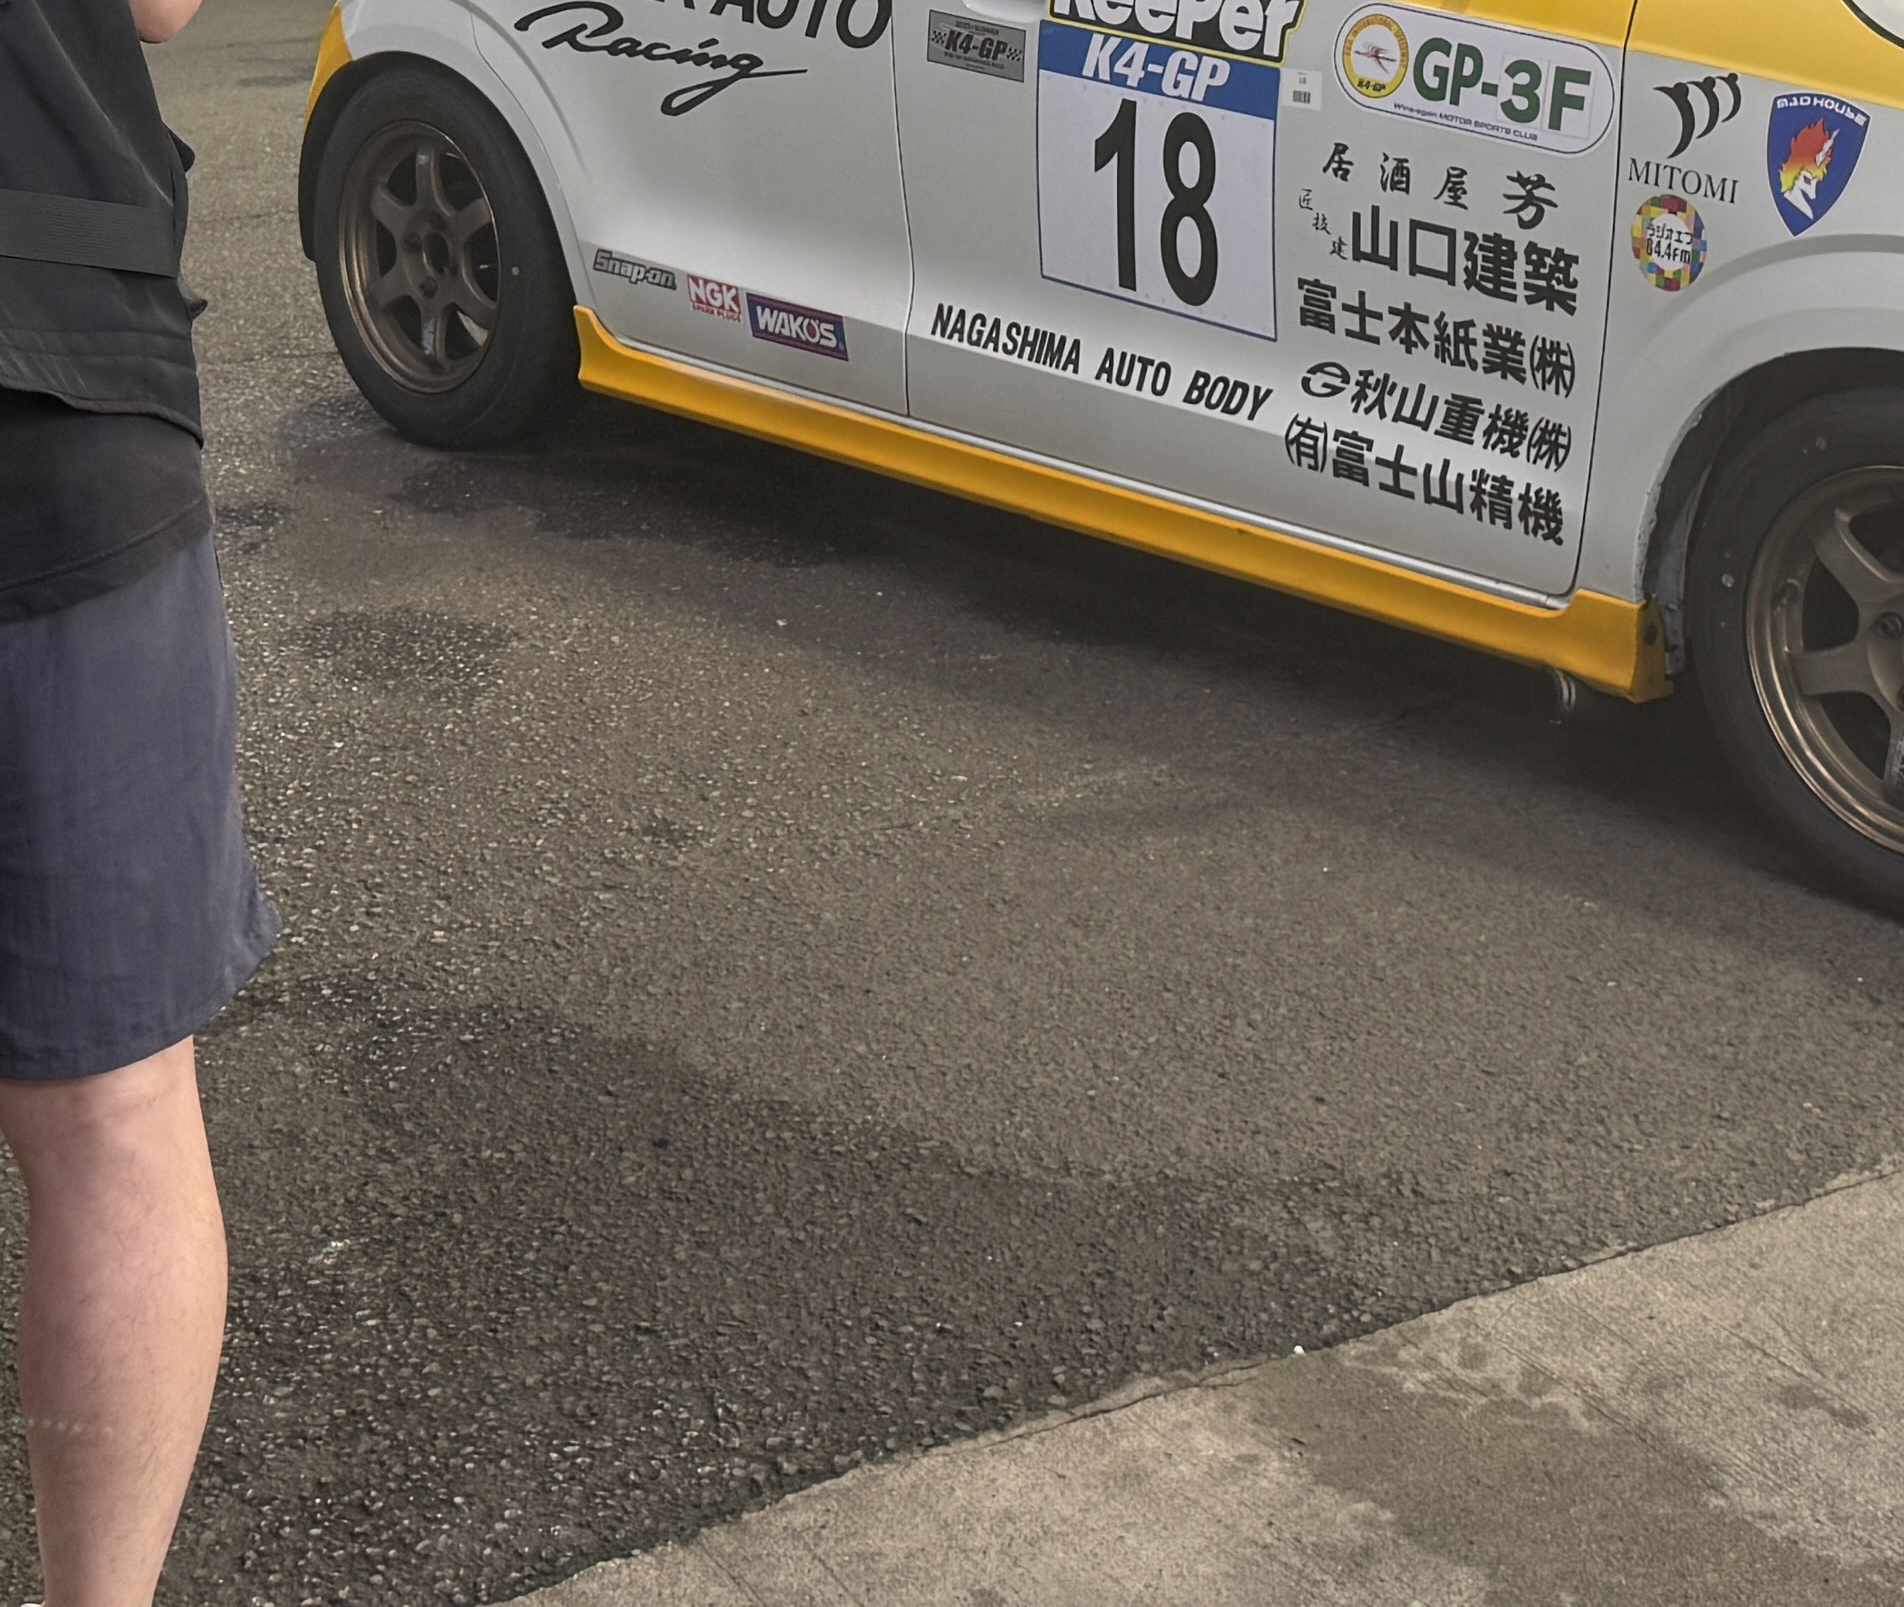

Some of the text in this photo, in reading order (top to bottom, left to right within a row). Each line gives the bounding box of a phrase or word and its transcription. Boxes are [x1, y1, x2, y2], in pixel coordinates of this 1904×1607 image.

[513, 0, 808, 116] Racing
[944, 28, 1009, 61] K4-GP
[1082, 32, 1230, 103] K4-GP
[1412, 36, 1592, 132] GP-3F
[1094, 98, 1219, 307] 18
[1322, 140, 1559, 230] 居酒屋芳
[1628, 157, 1740, 204] MITOMI
[593, 249, 677, 290] Snap-on
[688, 276, 742, 313] NGK
[1351, 203, 1581, 317] 山口建築
[931, 302, 1273, 422] NAGASHIMA AUTO BODY
